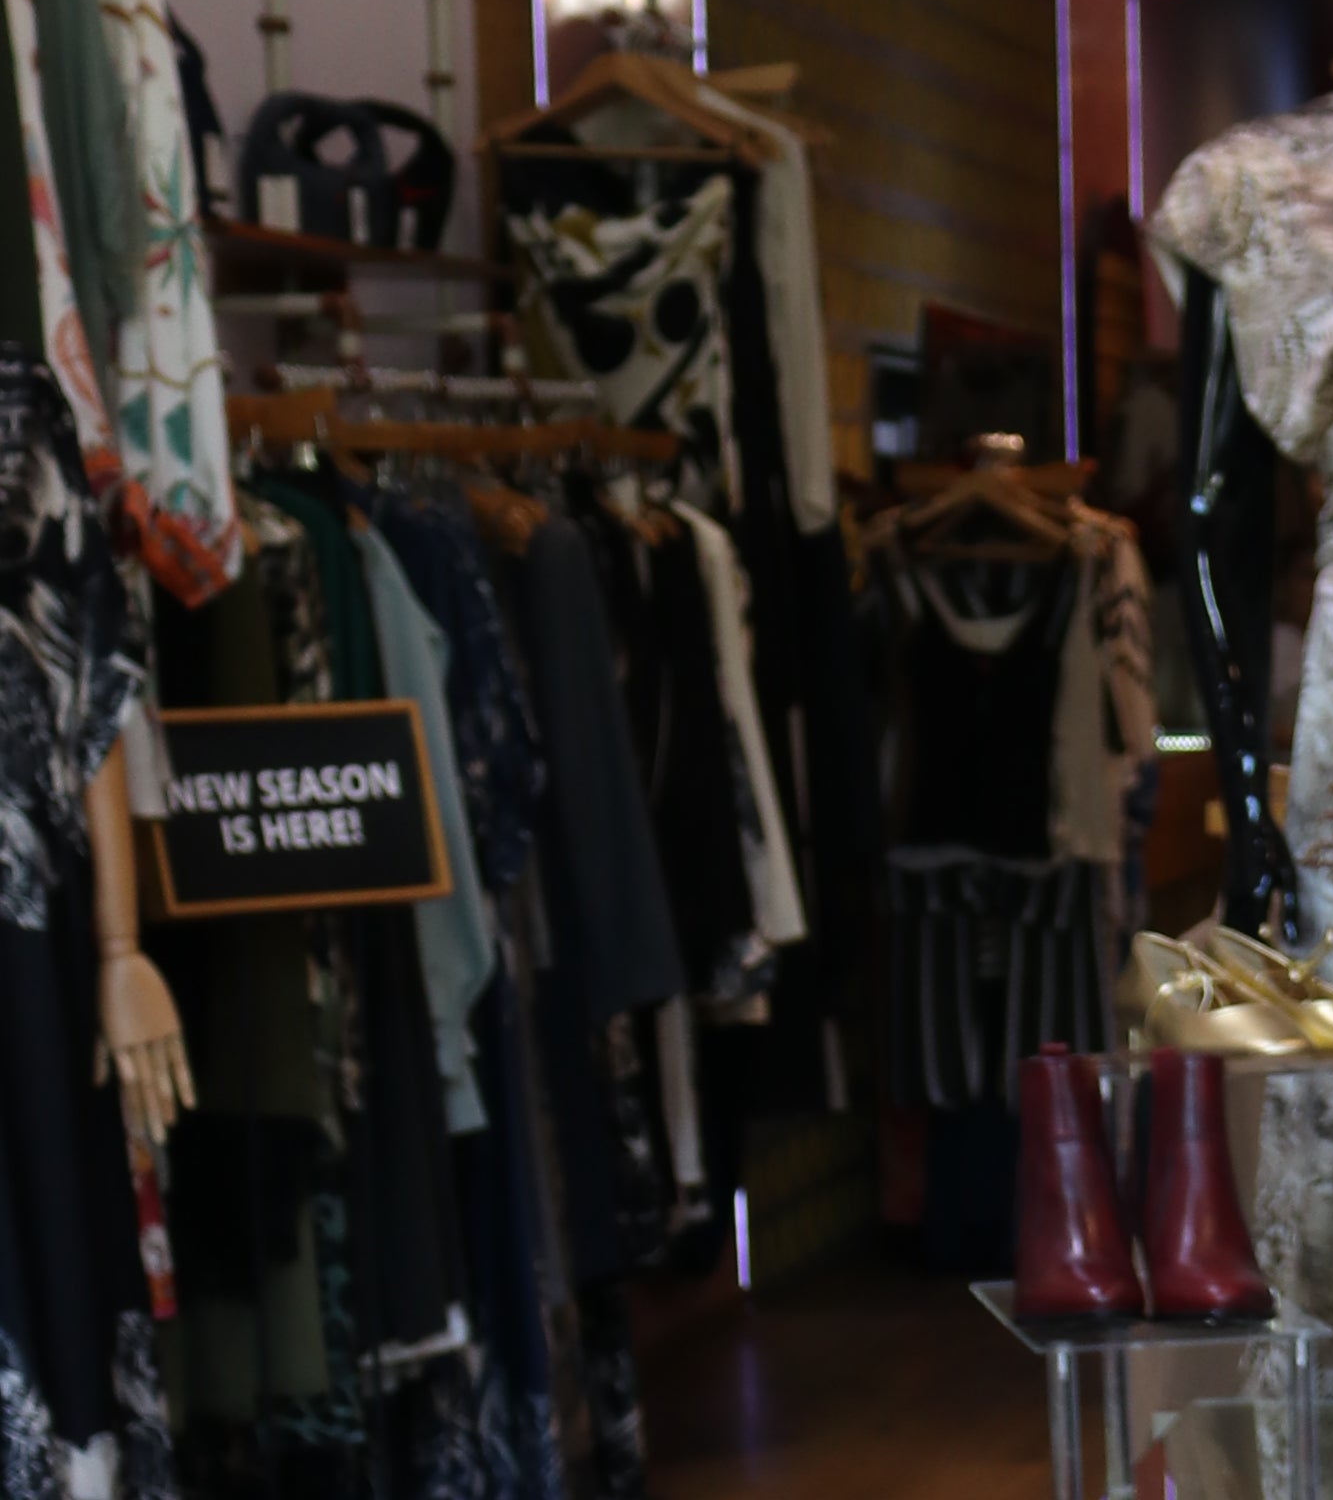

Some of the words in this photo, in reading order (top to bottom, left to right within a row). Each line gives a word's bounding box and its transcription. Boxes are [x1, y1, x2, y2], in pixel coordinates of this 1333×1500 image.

[166, 770, 251, 814] NEW
[256, 759, 402, 808] SEASON
[220, 814, 257, 855] IS
[259, 806, 365, 851] HERE!
